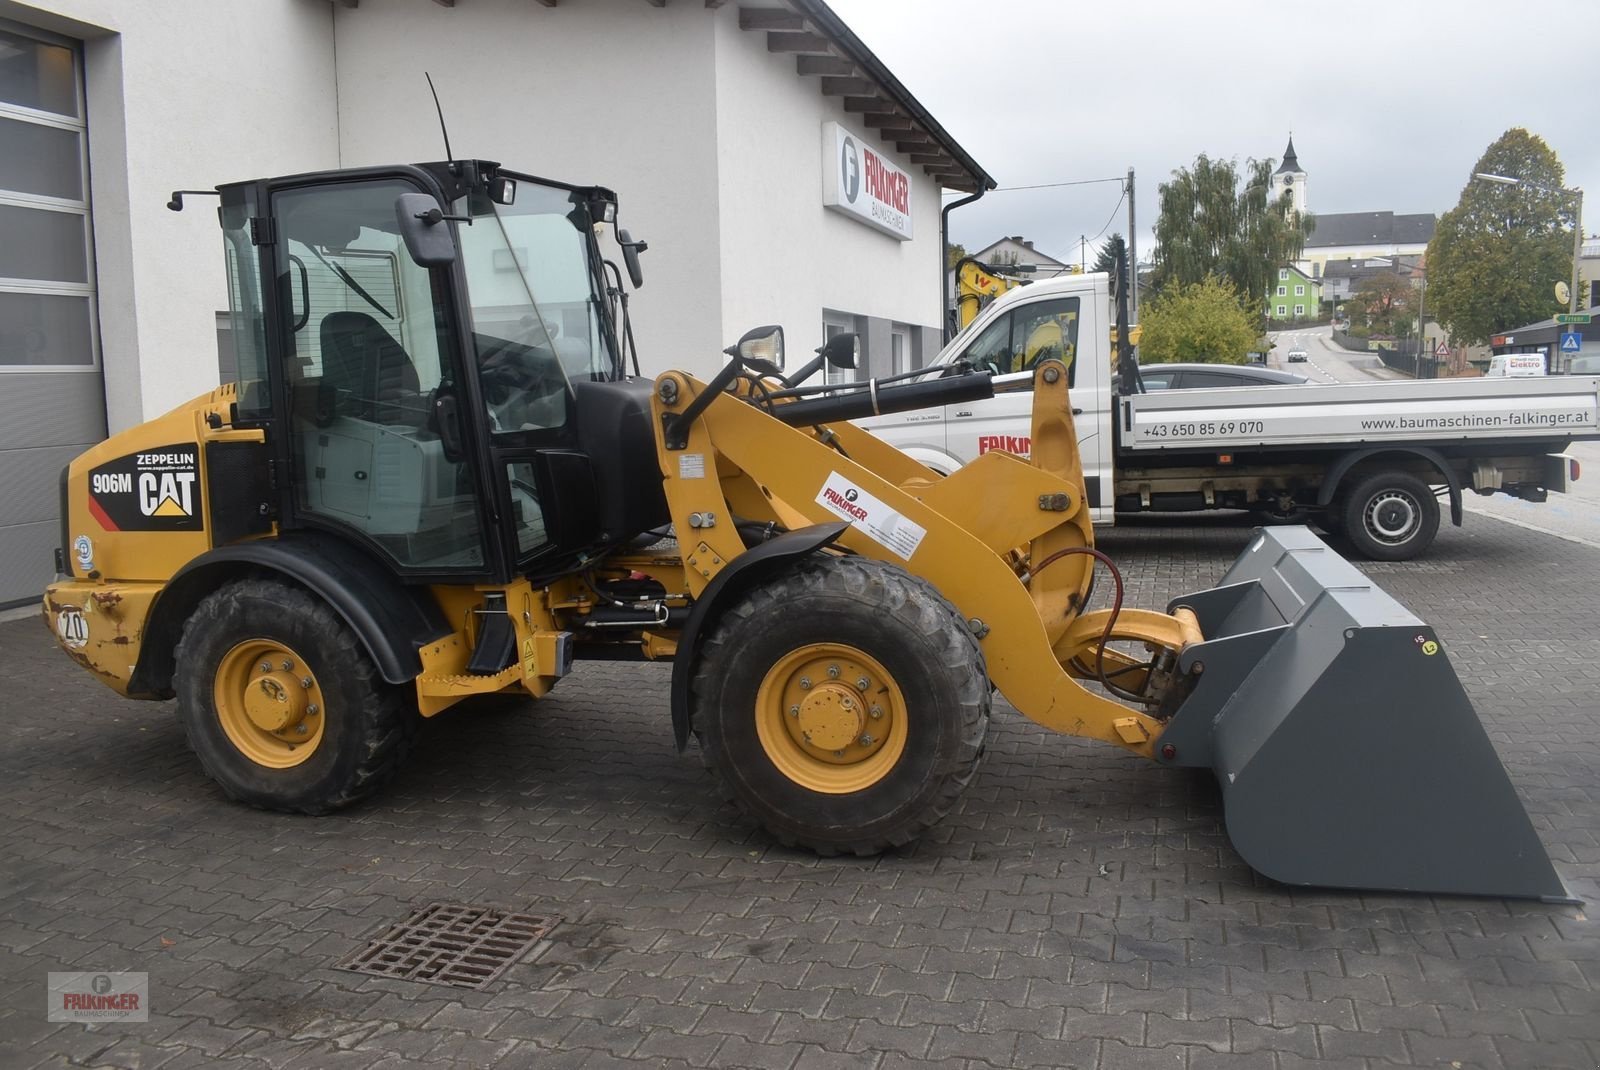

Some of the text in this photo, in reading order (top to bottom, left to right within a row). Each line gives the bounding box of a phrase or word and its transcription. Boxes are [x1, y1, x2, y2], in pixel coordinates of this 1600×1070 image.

[863, 147, 909, 217] FALKINGER
[872, 201, 905, 231] BAUMASCHINEN
[1143, 421, 1264, 437] +43 650 85 69 070
[1361, 410, 1589, 429] www.baumaschinen-falkinger.at
[978, 435, 1031, 456] FALKIN
[136, 453, 195, 465] ZEPPELIN
[93, 473, 132, 493] 906M
[138, 472, 196, 516] CAT
[823, 487, 868, 522] FALKINGER
[62, 612, 83, 641] 20
